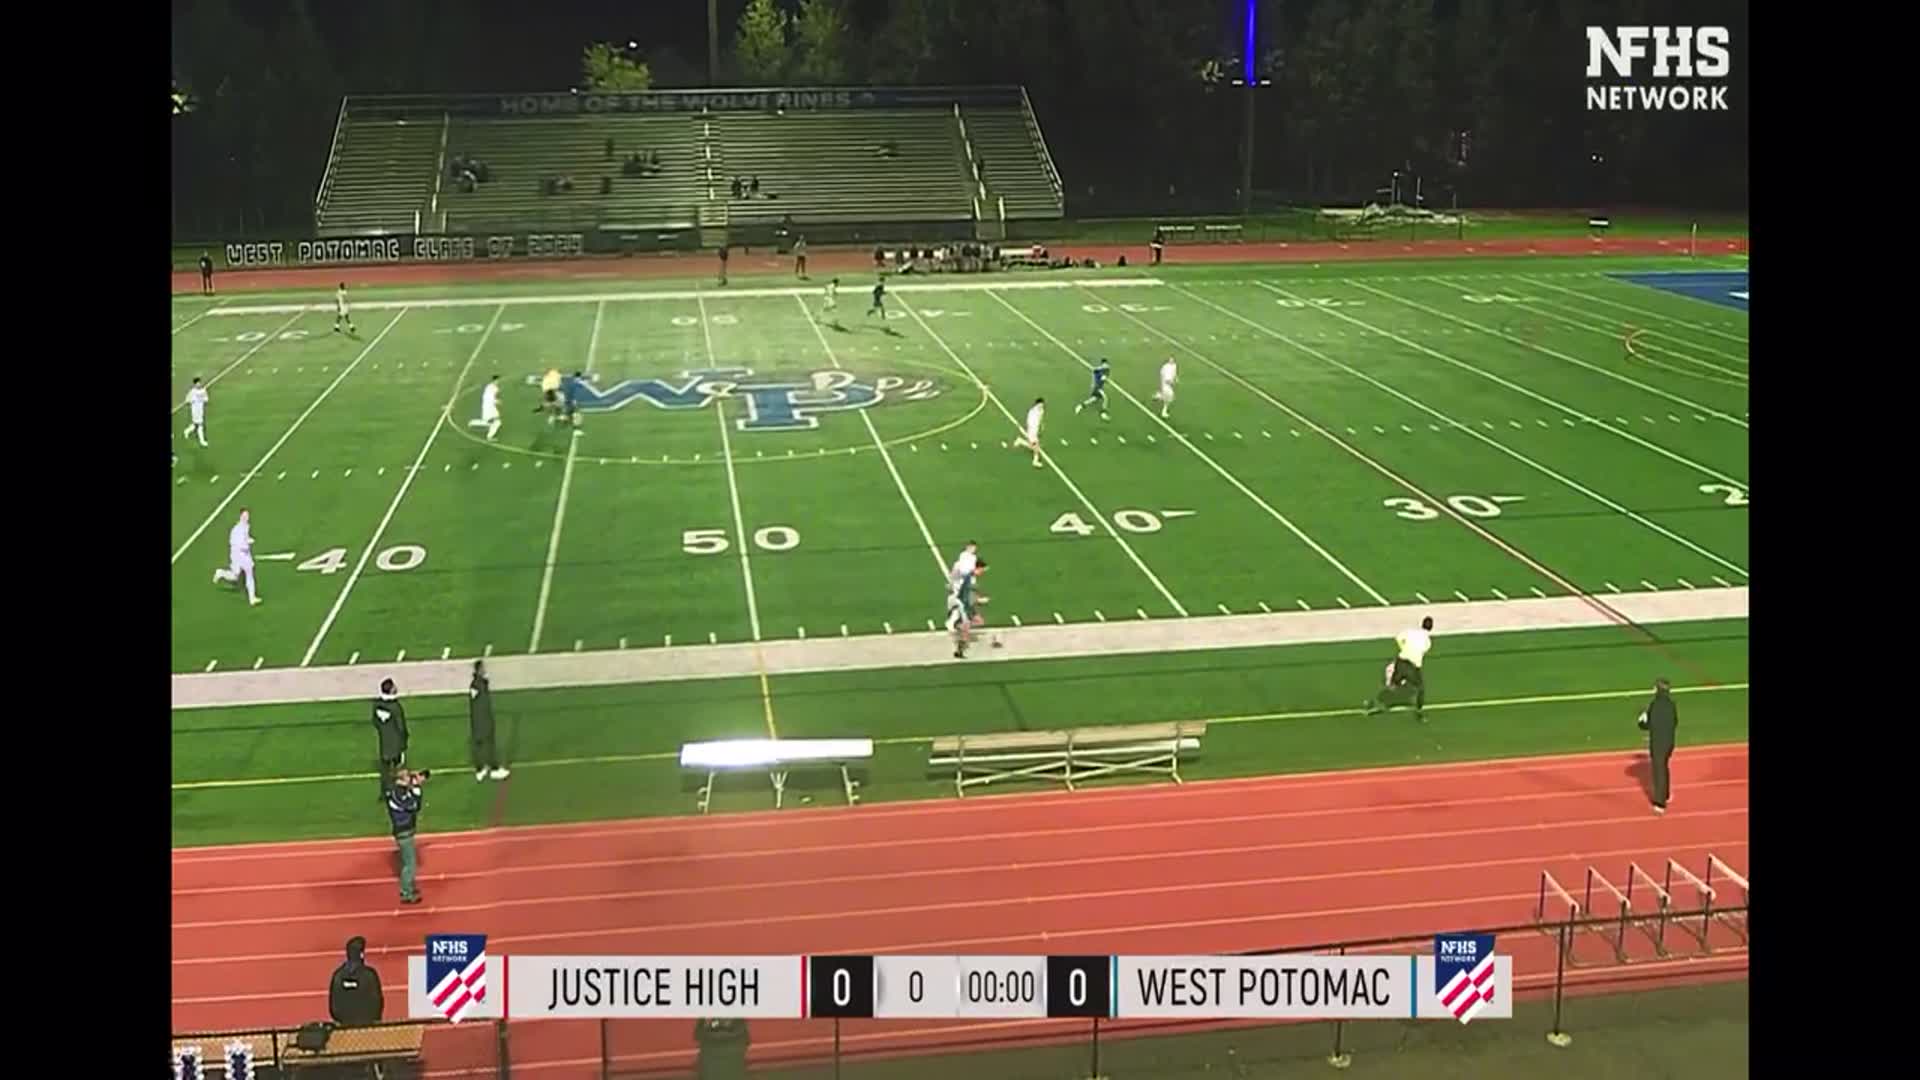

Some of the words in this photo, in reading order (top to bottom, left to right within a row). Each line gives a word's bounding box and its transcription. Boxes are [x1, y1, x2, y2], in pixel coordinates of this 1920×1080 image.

[225, 244, 283, 265] WEST
[299, 239, 400, 263] POTOMAC
[413, 237, 475, 260] CLASS
